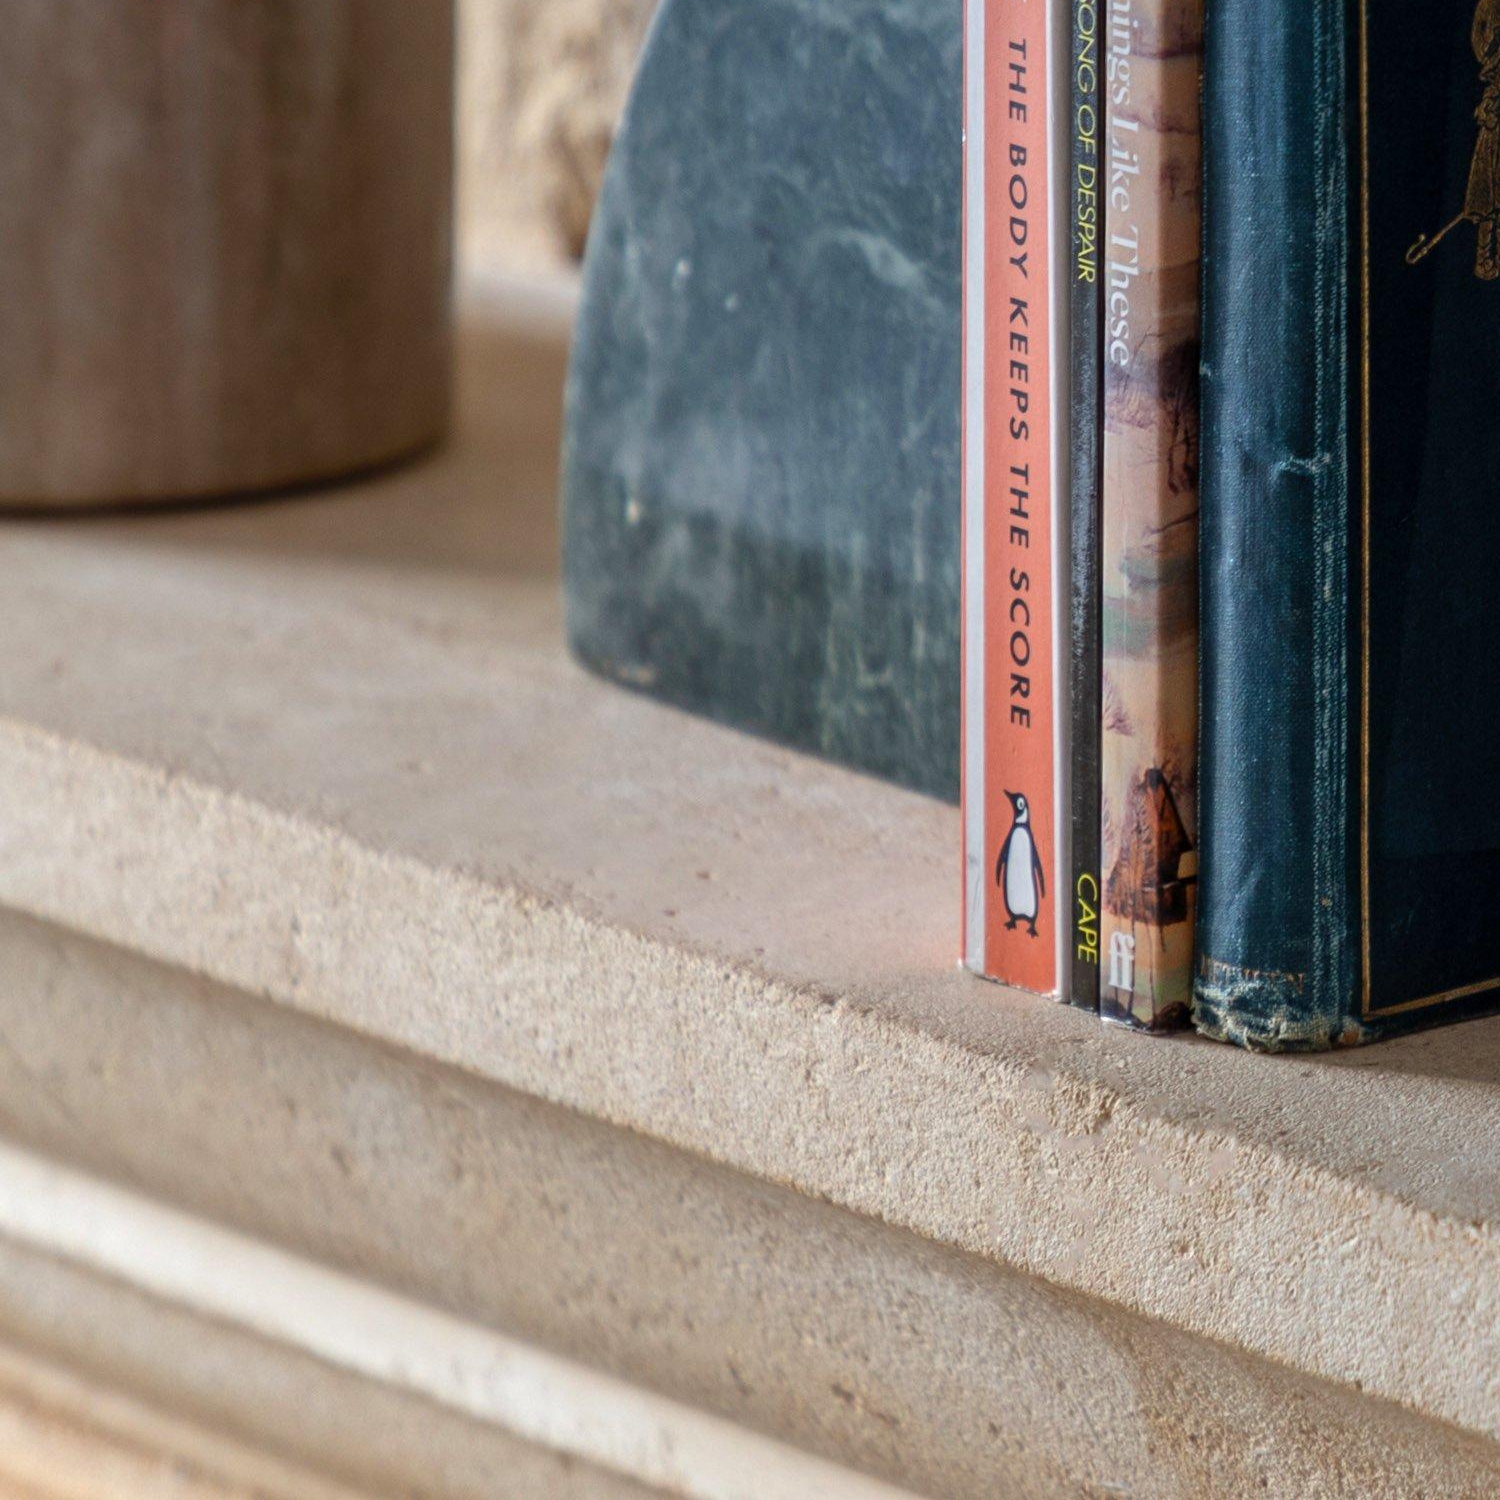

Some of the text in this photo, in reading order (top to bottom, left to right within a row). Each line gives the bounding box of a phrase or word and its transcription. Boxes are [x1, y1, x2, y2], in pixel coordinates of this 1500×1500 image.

[1078, 104, 1095, 154] OF
[1111, 116, 1140, 212] Like
[1077, 164, 1095, 283] DESPAIR
[1110, 224, 1139, 367] These
[1009, 38, 1030, 729] THE BODY KEEPS THE SCORE
[1077, 873, 1098, 965] CAPE
